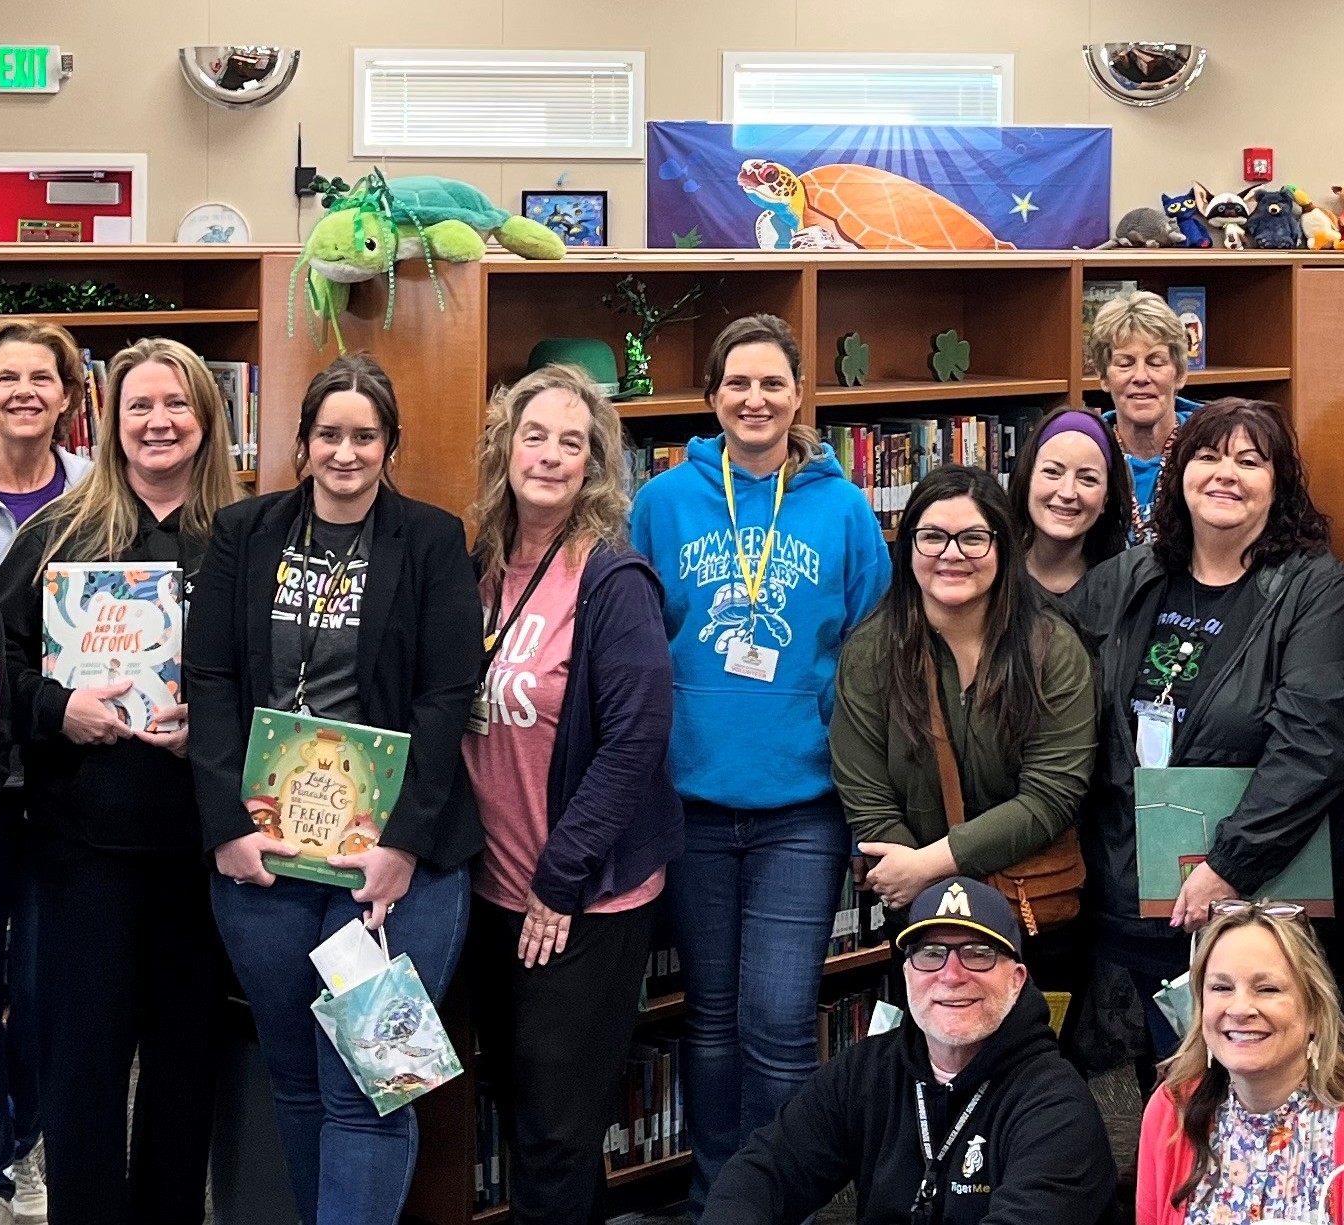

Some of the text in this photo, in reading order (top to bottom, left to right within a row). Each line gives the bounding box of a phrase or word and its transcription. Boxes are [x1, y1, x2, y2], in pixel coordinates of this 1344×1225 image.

[770, 530, 820, 586] LAKE
[97, 605, 128, 622] LEO
[81, 629, 144, 654] OCTOPUS
[288, 804, 341, 827] FRENCH
[293, 819, 332, 841] TOAST
[935, 891, 972, 917] M
